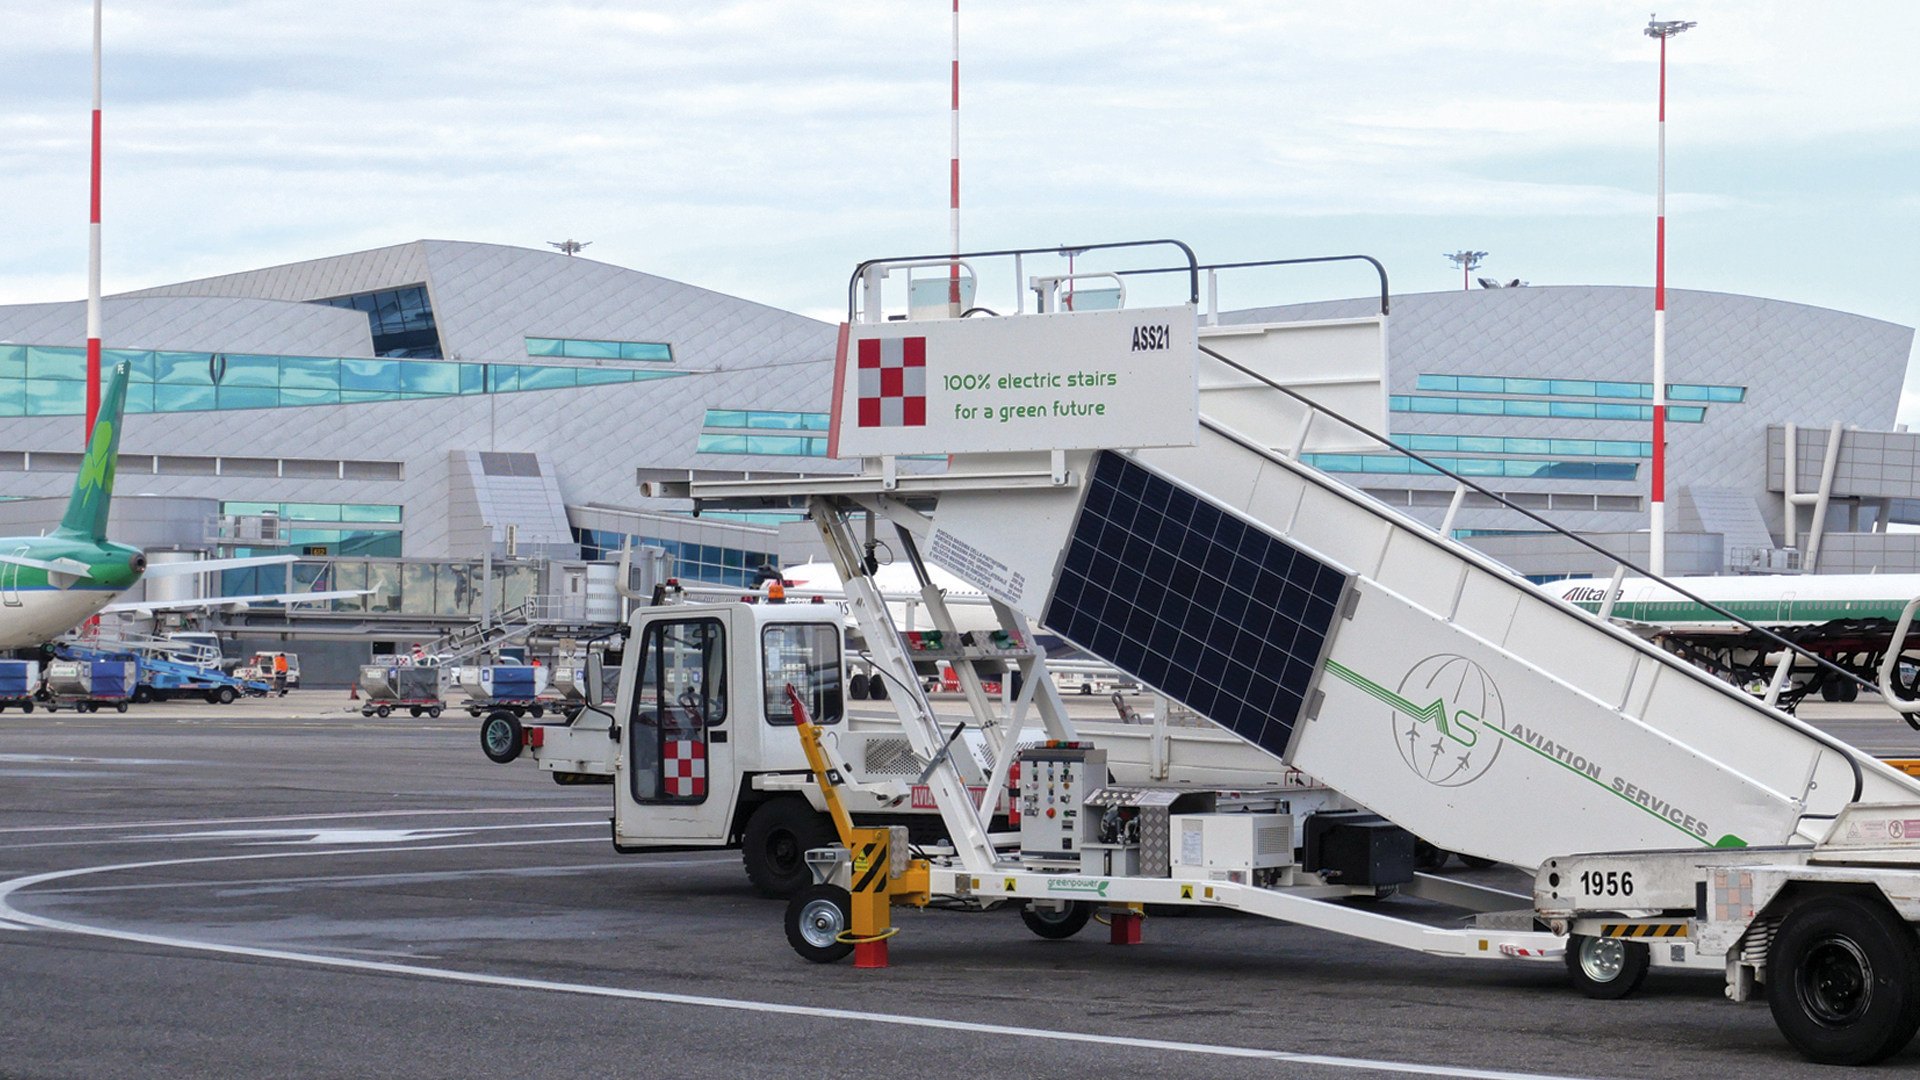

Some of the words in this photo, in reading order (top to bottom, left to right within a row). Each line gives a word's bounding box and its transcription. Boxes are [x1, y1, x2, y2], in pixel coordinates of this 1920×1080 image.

[1132, 325, 1170, 352] ASS21
[944, 374, 990, 391] 100%
[997, 373, 1061, 390] electric
[1067, 371, 1117, 388] stairs
[955, 404, 977, 420] for
[984, 406, 993, 420] a
[999, 405, 1047, 423] green
[1052, 400, 1106, 417] future
[1562, 587, 1624, 601] Alitala
[1510, 723, 1602, 780] AVIATION
[1611, 776, 1709, 838] SERVICES
[1047, 879, 1099, 888] greenpower
[1580, 870, 1634, 897] 1956
